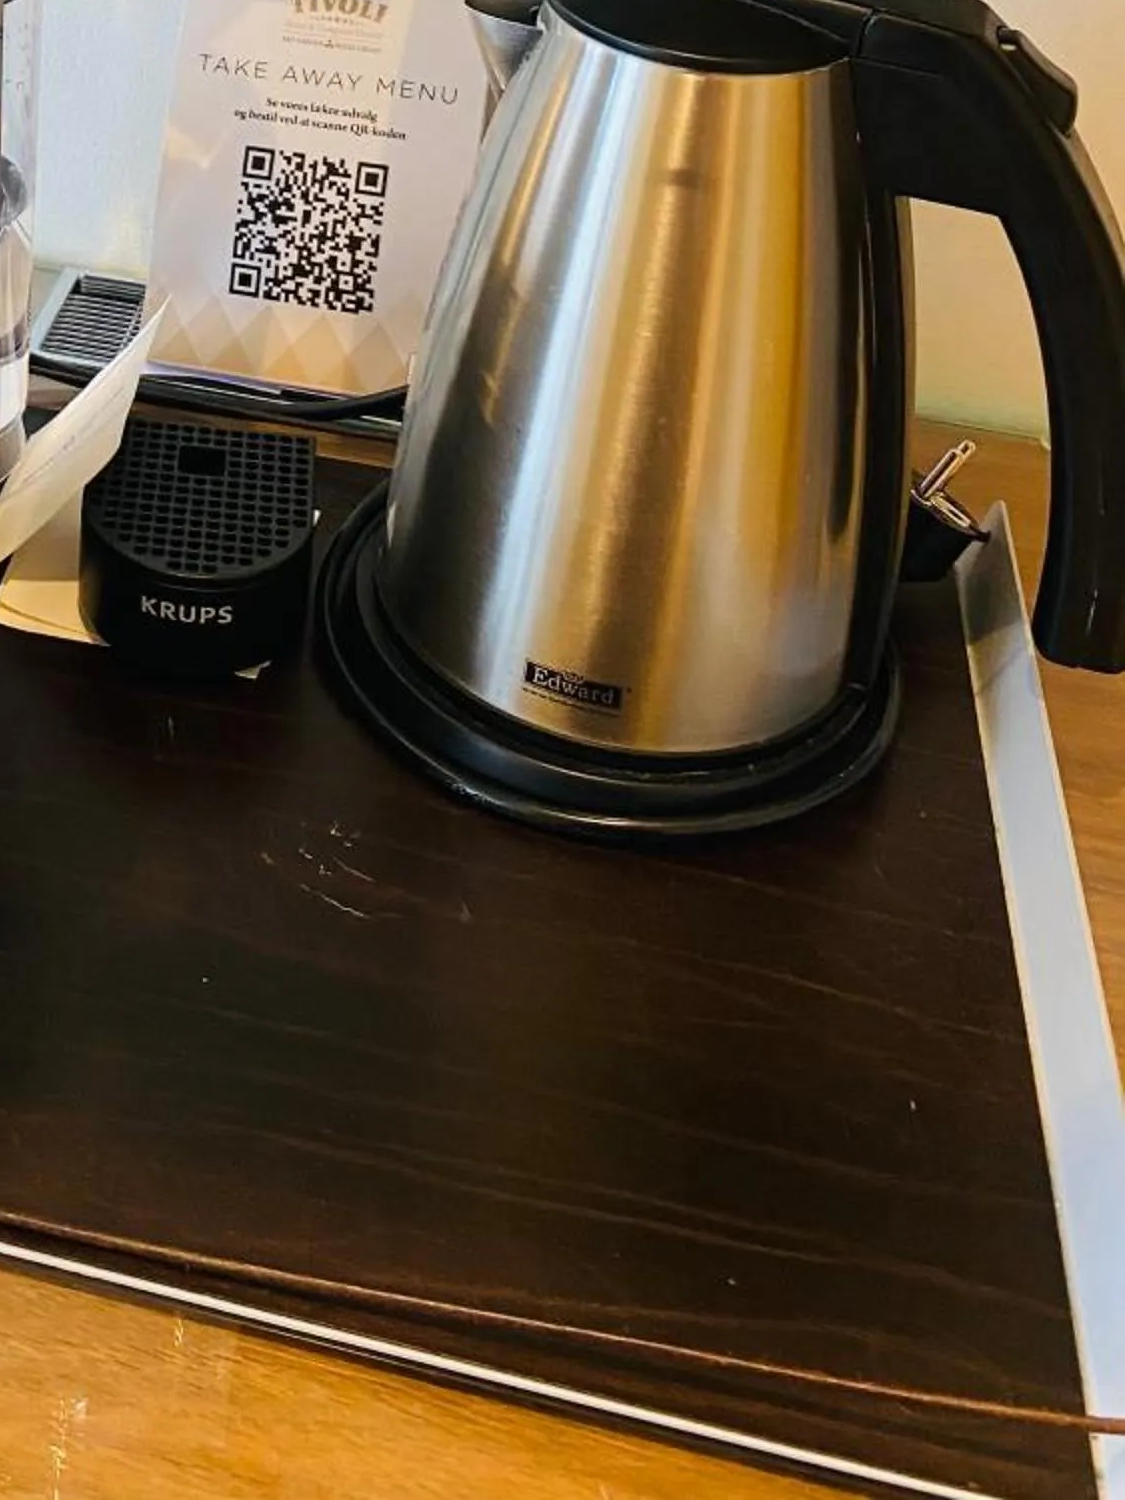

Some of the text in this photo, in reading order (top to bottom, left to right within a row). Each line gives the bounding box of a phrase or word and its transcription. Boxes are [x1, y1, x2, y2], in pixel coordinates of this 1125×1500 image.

[199, 53, 459, 105] TAKE AWAY MENU
[141, 595, 233, 625] KRUPS
[533, 666, 615, 705] Edward
